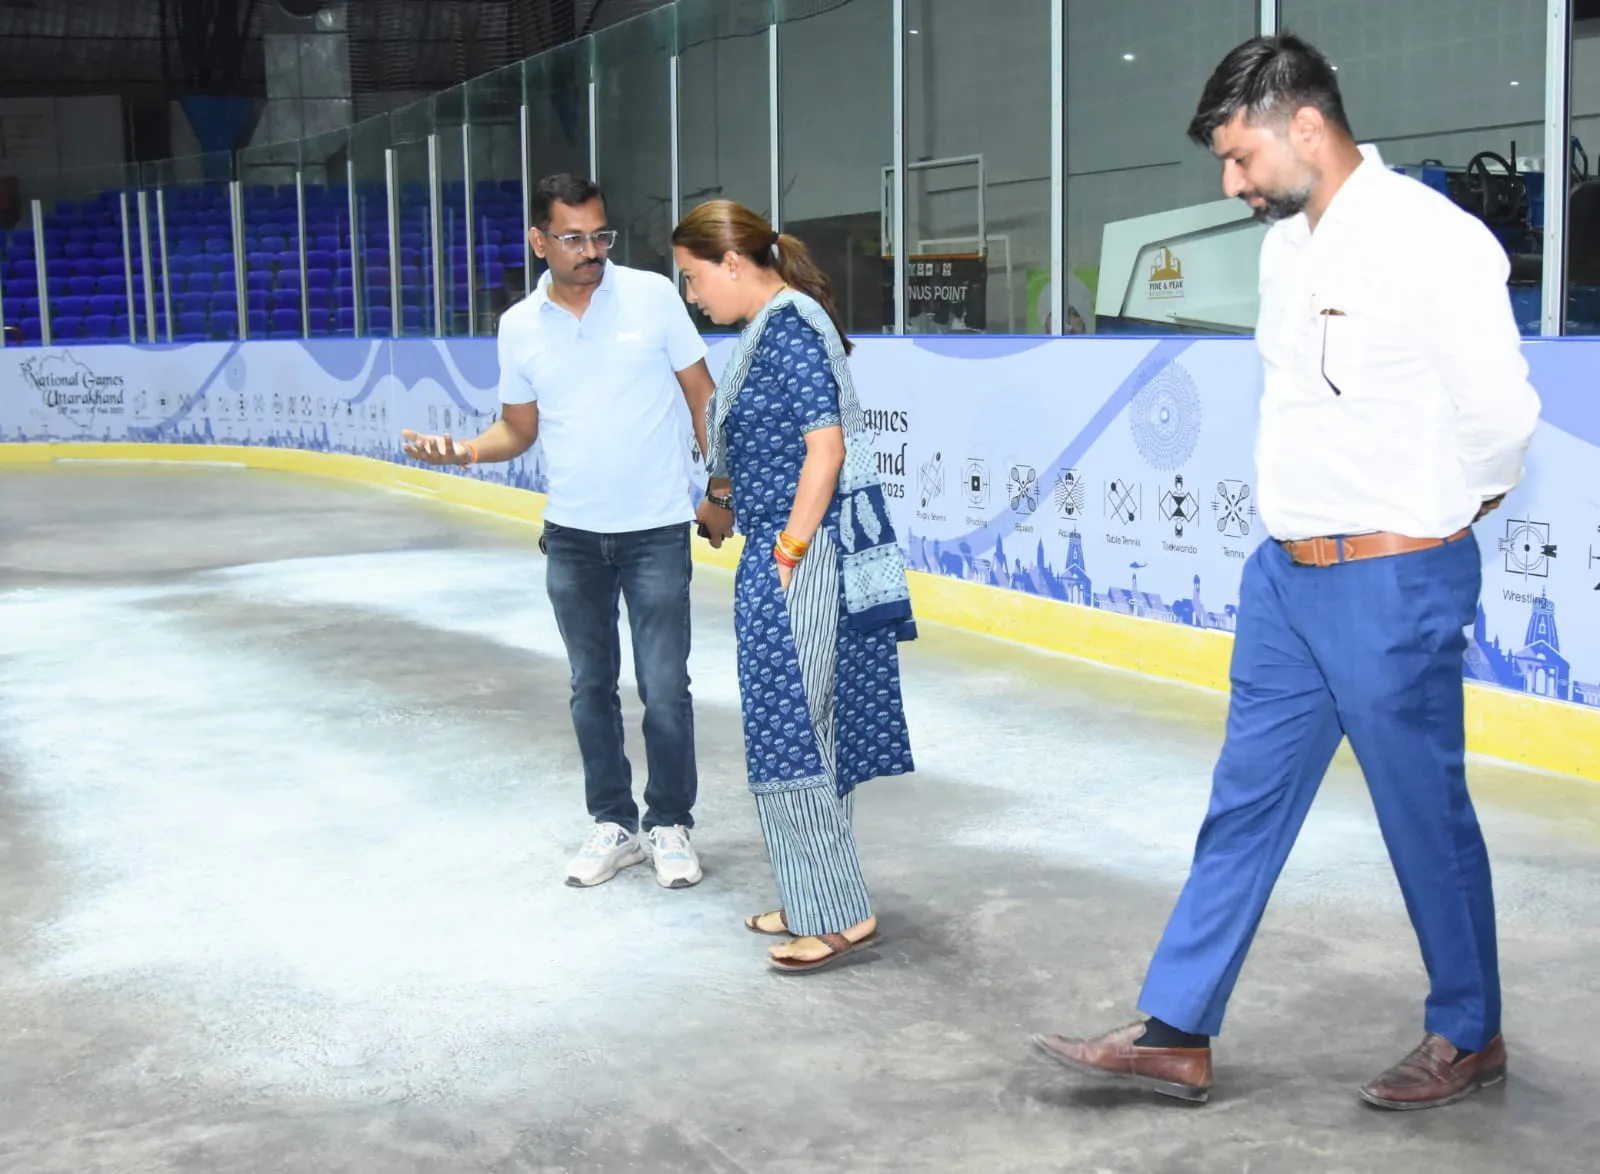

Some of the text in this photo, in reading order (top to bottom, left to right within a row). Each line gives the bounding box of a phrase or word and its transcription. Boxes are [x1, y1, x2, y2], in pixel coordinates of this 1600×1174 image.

[908, 286, 968, 300] NUS POINT
[1149, 282, 1162, 291] PINE
[1169, 280, 1184, 289] PEAK
[21, 371, 124, 391] National Games
[43, 389, 124, 407] Uttarakhand
[862, 408, 908, 433] ames
[1106, 534, 1141, 548] Table Tennis
[1223, 547, 1245, 559] Tennis
[1502, 589, 1547, 609] Wrestling
